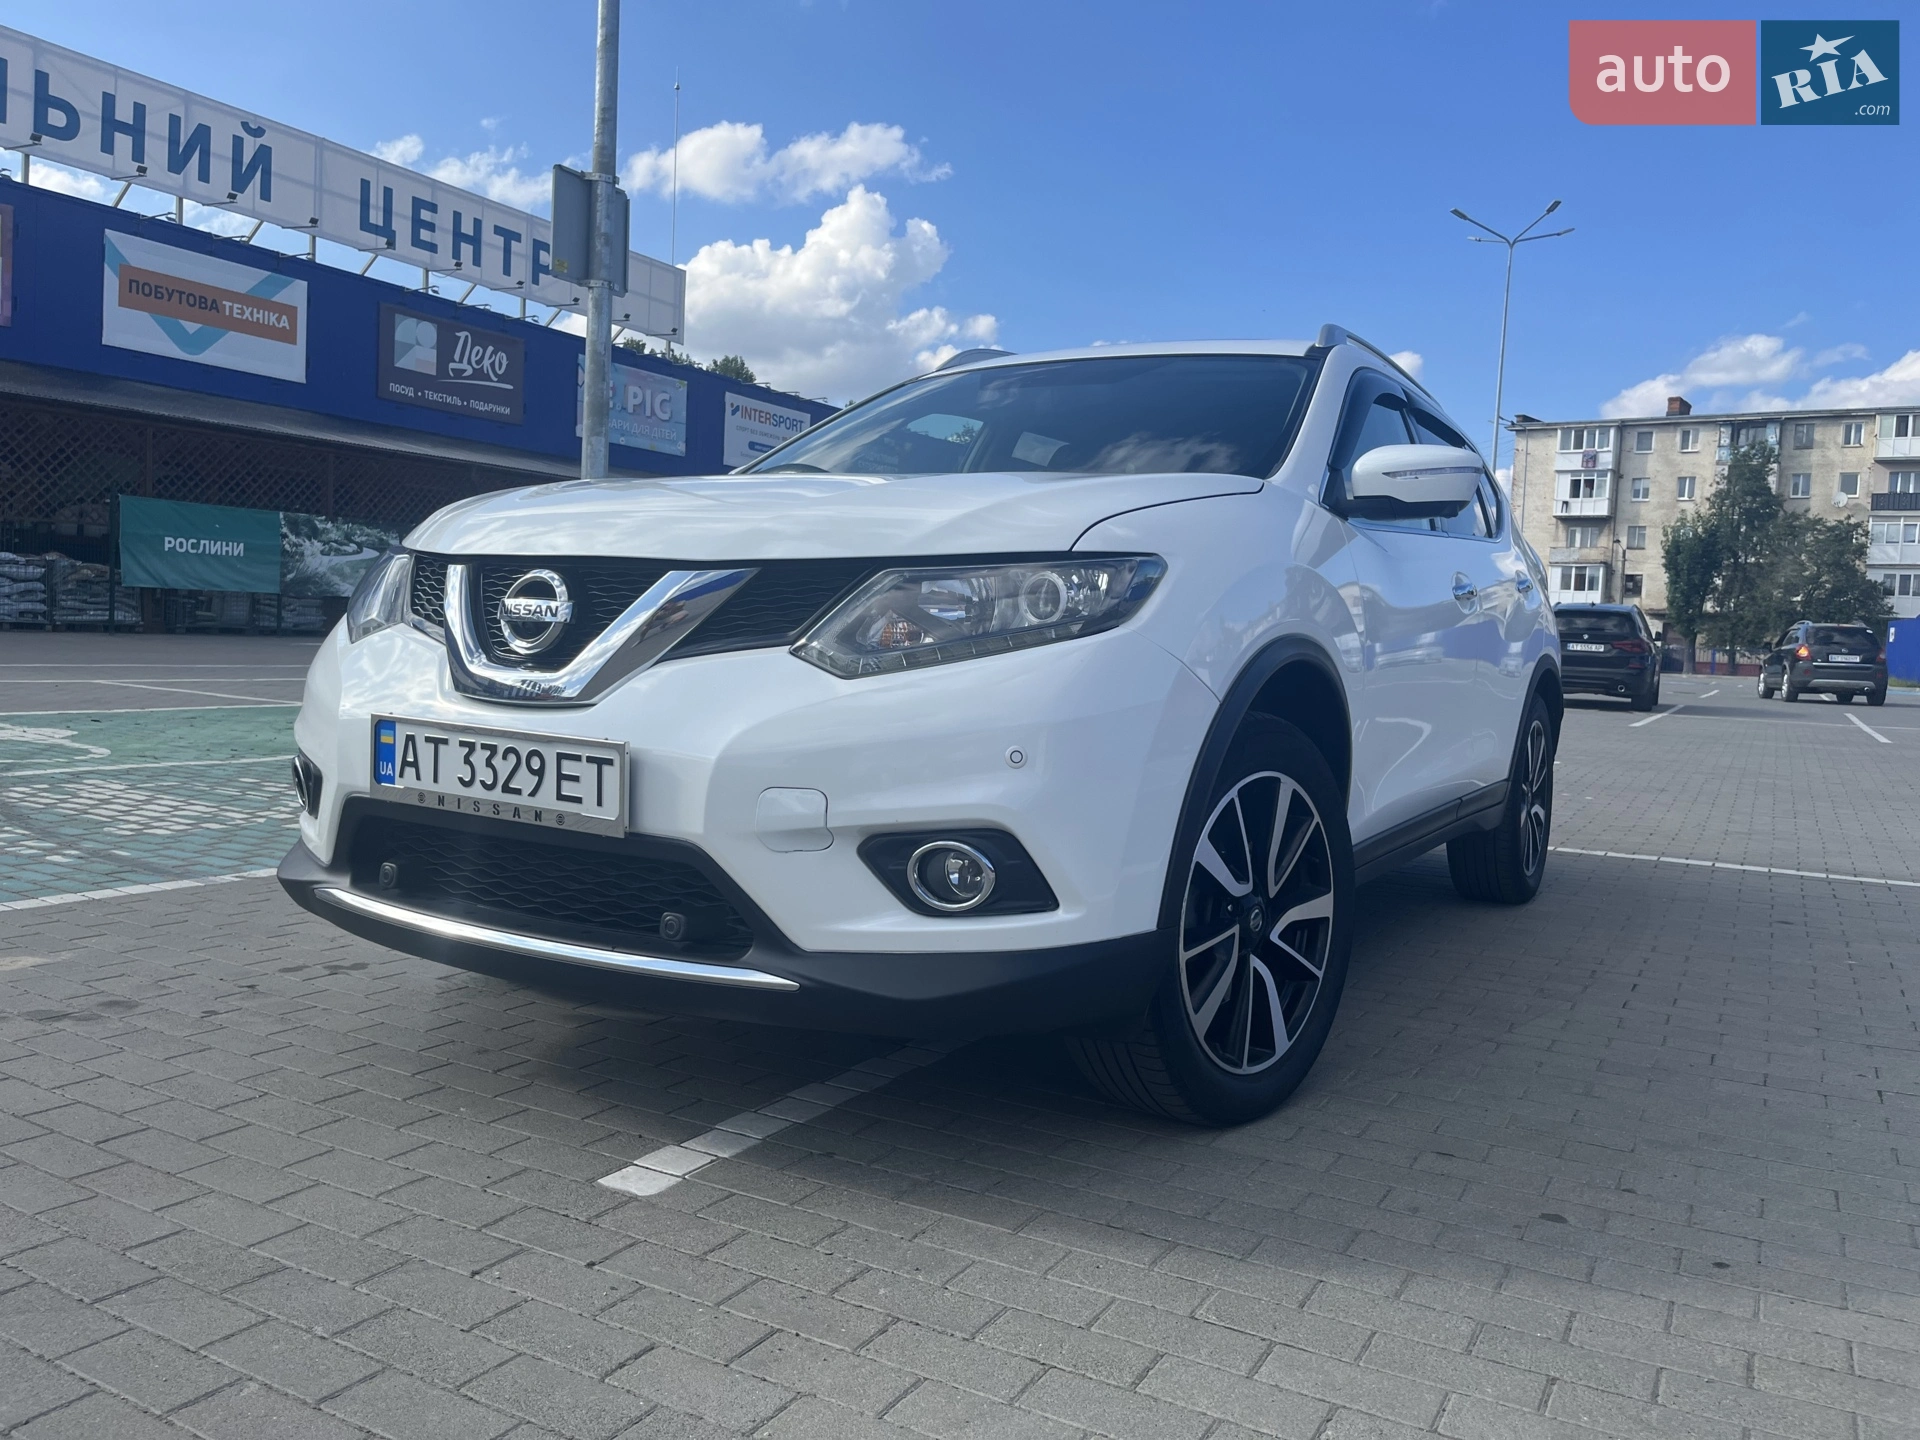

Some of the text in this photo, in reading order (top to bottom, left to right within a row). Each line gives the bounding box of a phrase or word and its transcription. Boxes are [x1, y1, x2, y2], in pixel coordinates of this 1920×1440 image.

[128, 278, 290, 330] ПОБУТОВА ТЕХНІКА
[448, 331, 509, 381] Деко
[389, 383, 510, 415] ПОСУД ТЕКСТИЛЬ ПОДАРУНКИ
[740, 404, 805, 433] INTERSPORT
[164, 536, 244, 557] РОСЛИНИ
[501, 601, 560, 618] NISSAN
[379, 760, 394, 777] UA
[398, 731, 615, 808] AT 3329 ET
[437, 794, 543, 823] NISSAN
